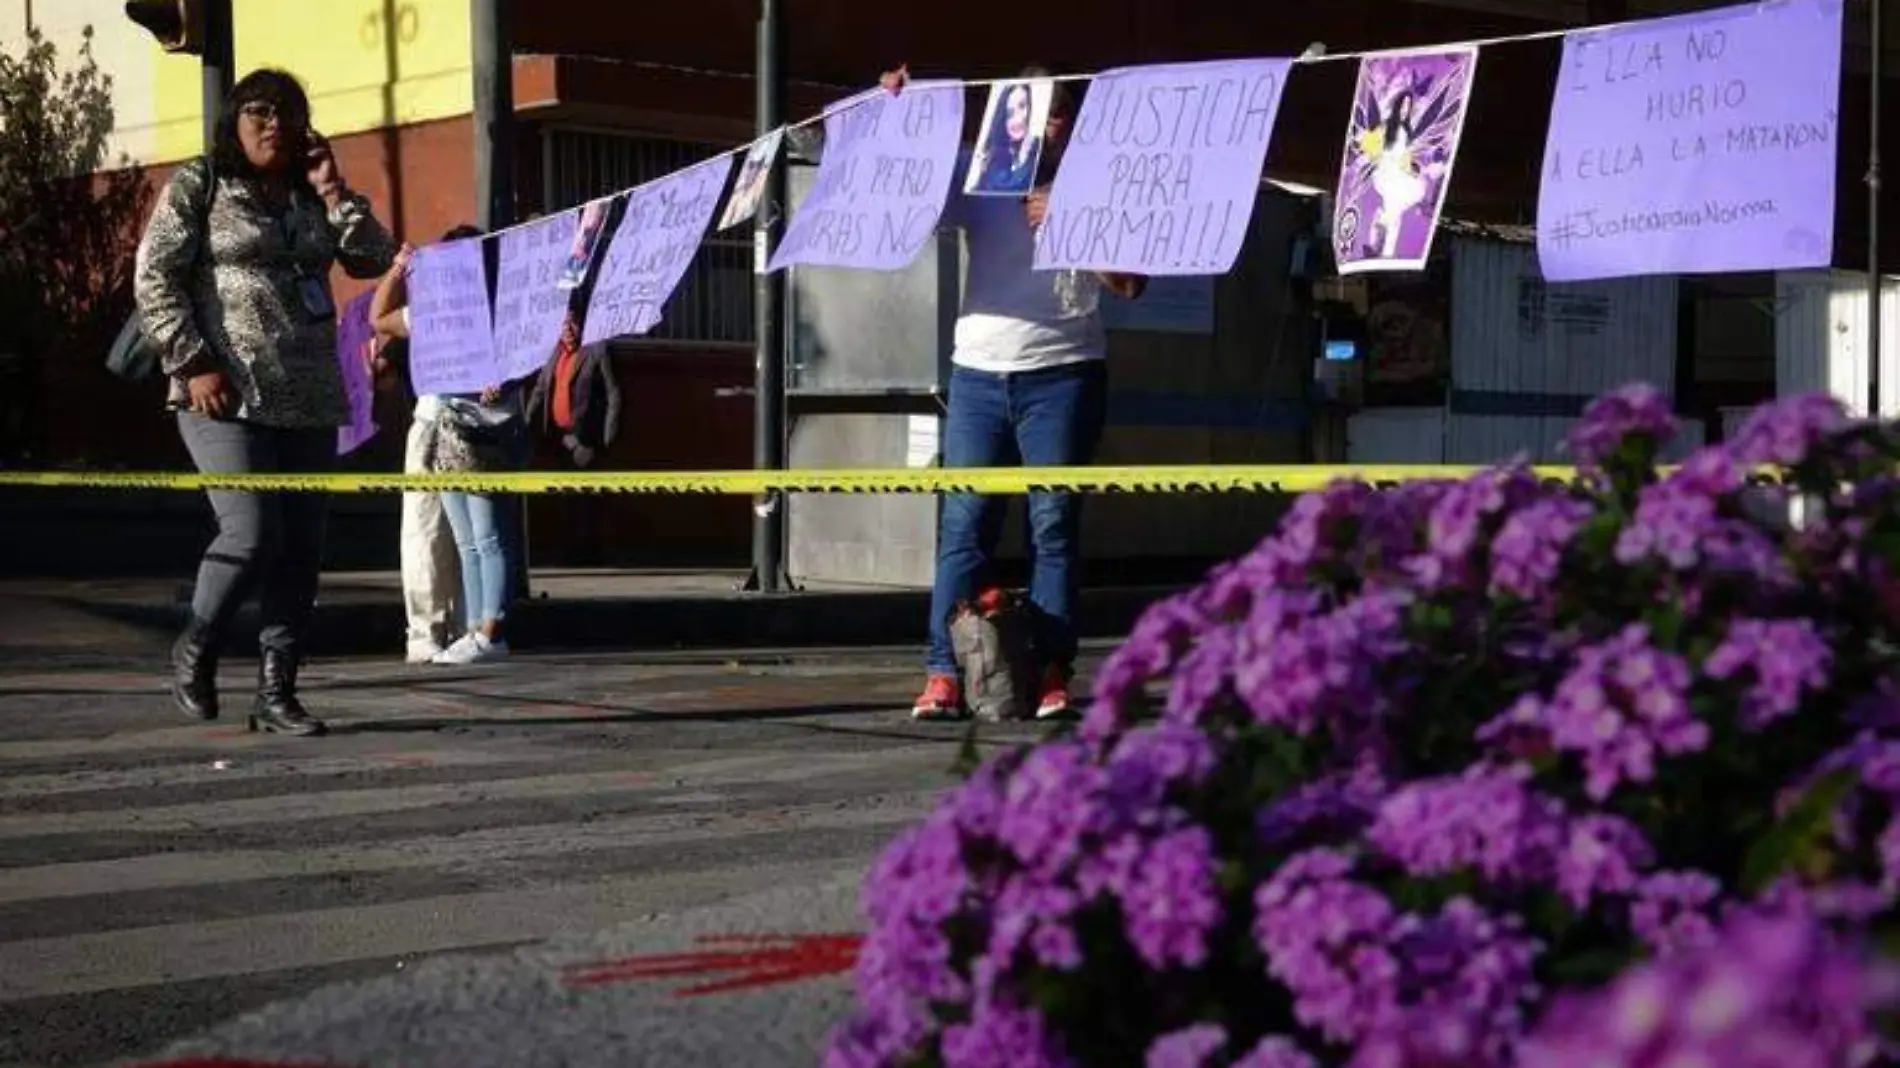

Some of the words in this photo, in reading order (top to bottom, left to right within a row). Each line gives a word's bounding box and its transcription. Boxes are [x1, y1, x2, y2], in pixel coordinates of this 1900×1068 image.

[1686, 30, 1727, 62] NO
[1076, 70, 1277, 148] JUSTICIA
[871, 155, 934, 197] PERO
[1108, 152, 1194, 207] PARA
[1577, 145, 1644, 178] ELLA
[1672, 137, 1705, 161] LA
[1036, 200, 1233, 268] NORMA!!!
